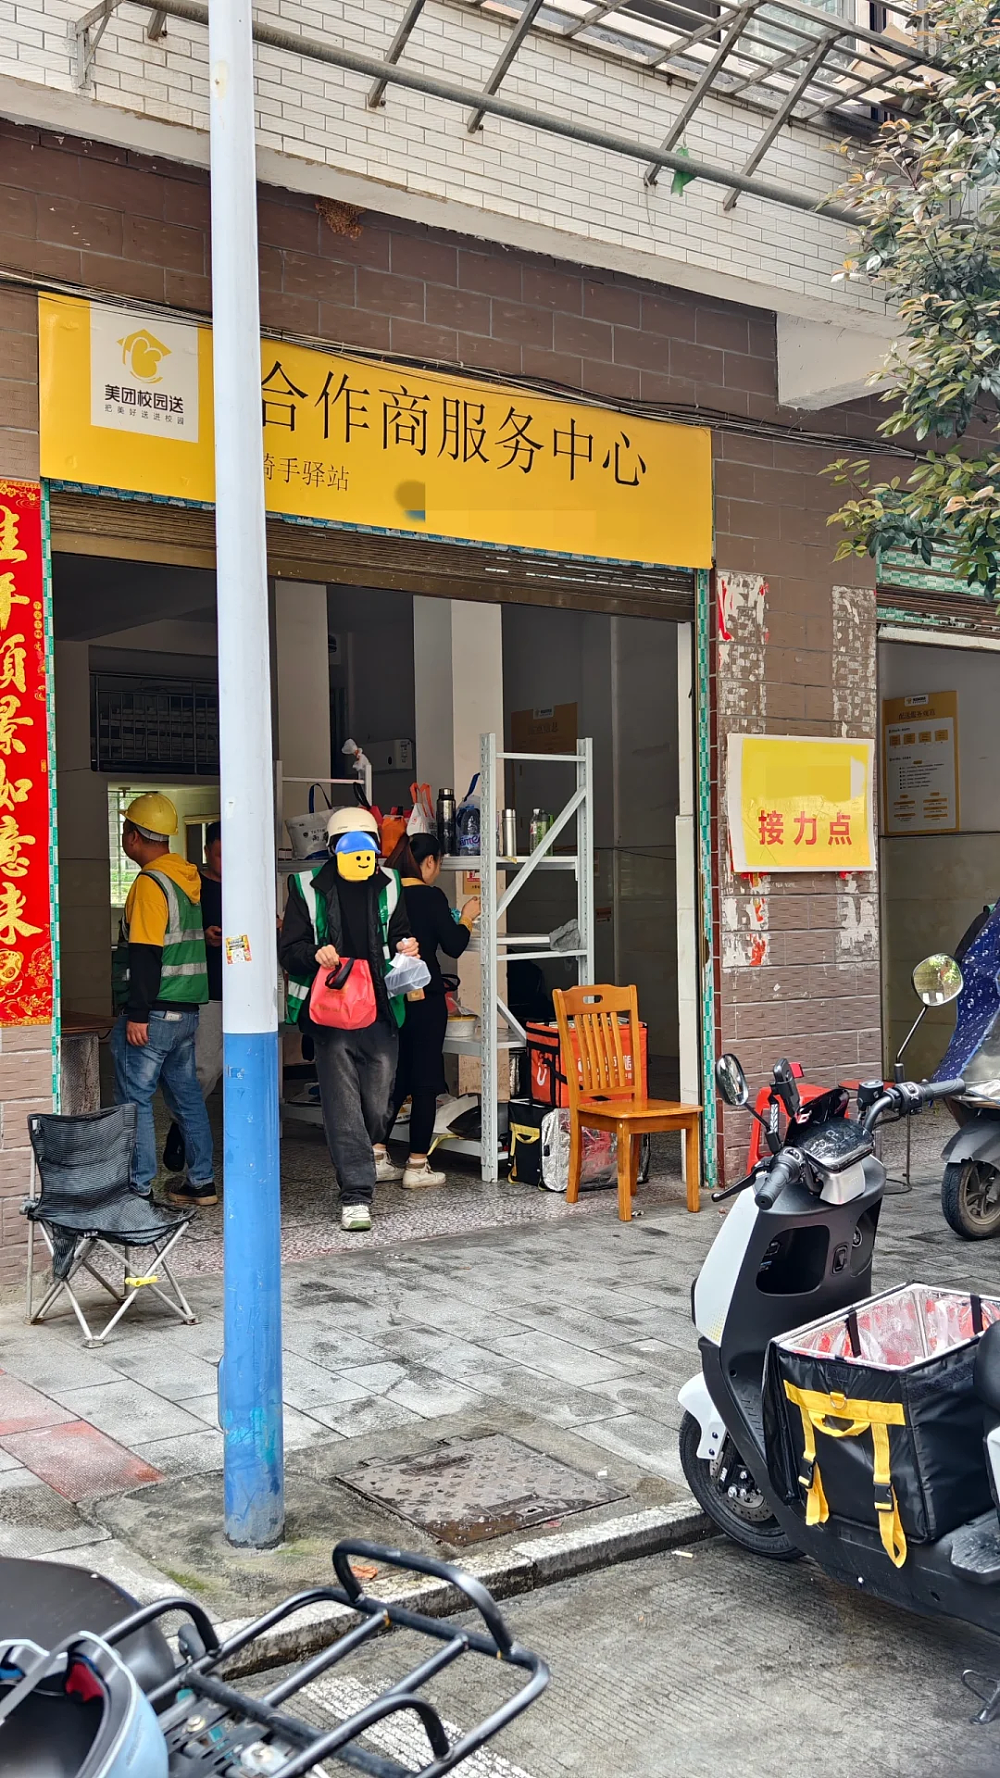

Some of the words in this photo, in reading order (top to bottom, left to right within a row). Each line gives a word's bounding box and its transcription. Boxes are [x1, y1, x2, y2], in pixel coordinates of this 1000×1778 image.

[104, 383, 184, 414] 美团校园送
[104, 404, 184, 425] 把美好送进校园
[262, 360, 647, 487] 合作商服务中心
[758, 810, 852, 845] 接力点
